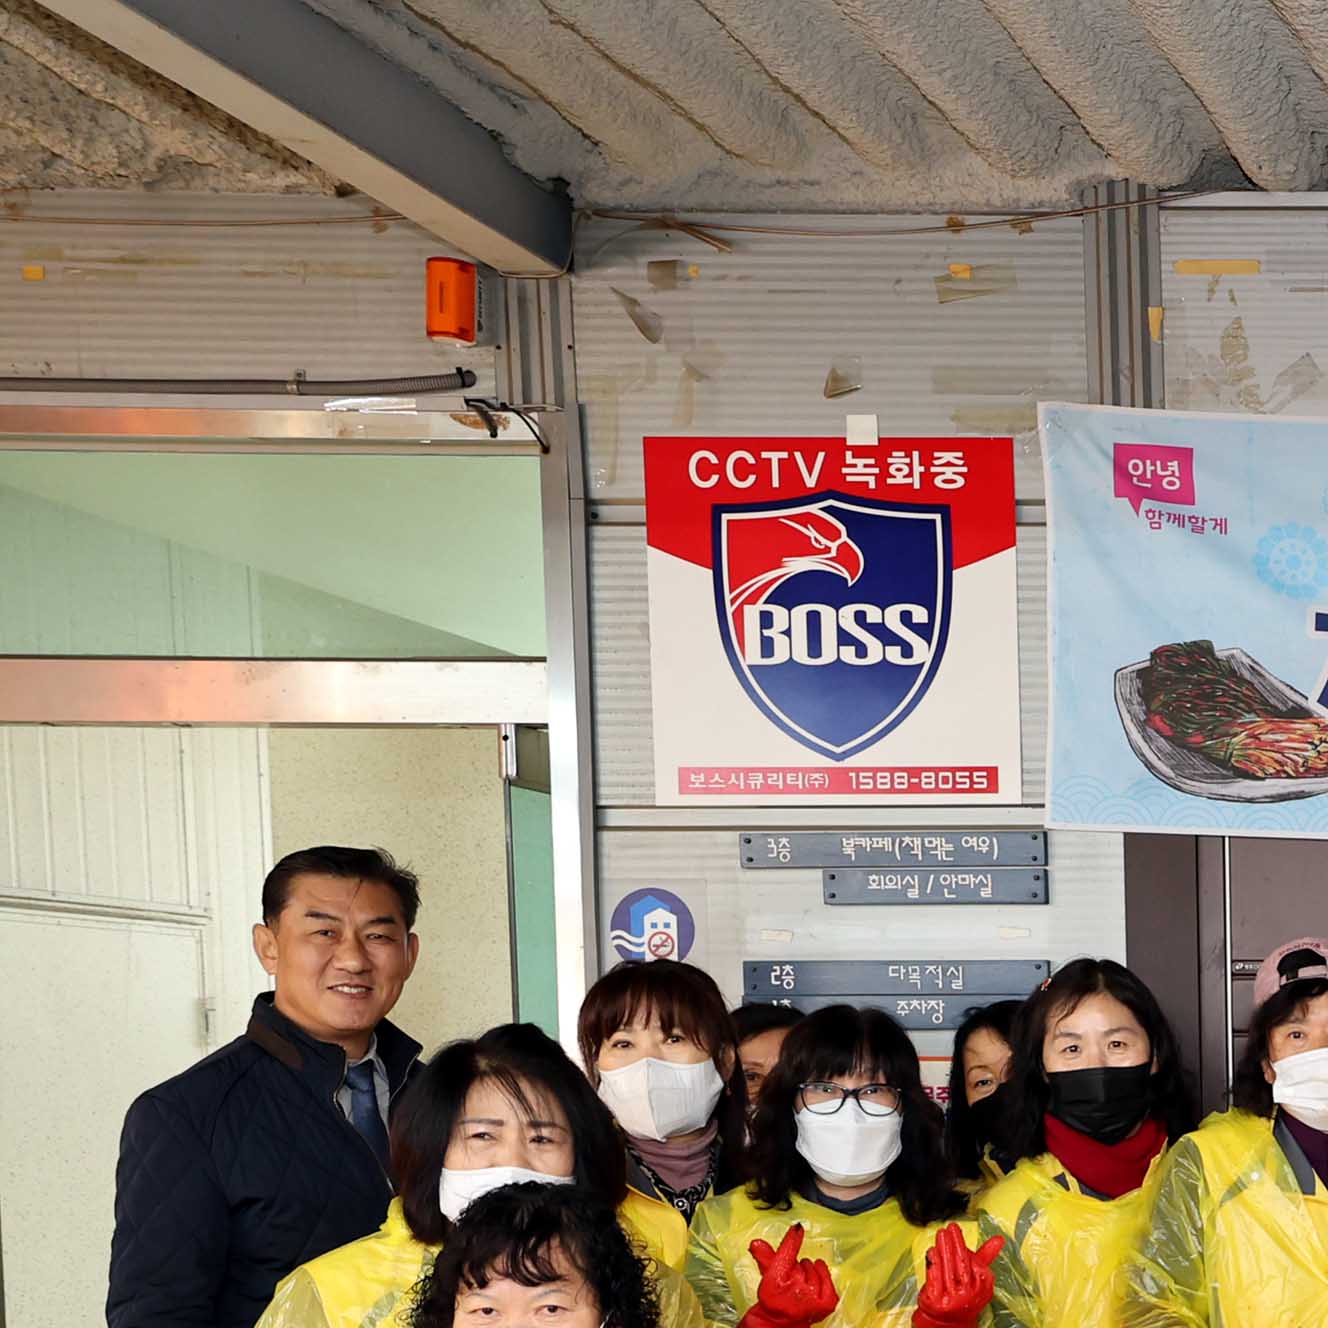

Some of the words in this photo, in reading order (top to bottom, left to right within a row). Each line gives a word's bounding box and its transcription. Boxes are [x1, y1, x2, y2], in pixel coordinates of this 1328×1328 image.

[688, 451, 824, 489] CCTV
[839, 448, 970, 492] 녹화중
[1126, 456, 1183, 492] 안녕
[1143, 507, 1230, 538] 함께할게
[743, 602, 931, 667] BOSS
[687, 771, 830, 790] 보스시큐리티(주)
[848, 771, 989, 790] 1588-8055
[766, 837, 792, 863] 3층
[961, 835, 999, 861] 여우)
[867, 874, 920, 899] 회의실
[939, 873, 994, 899] 안마실
[770, 965, 796, 990] 2층
[888, 965, 966, 991] 다목적실
[896, 999, 945, 1024] 주차장
